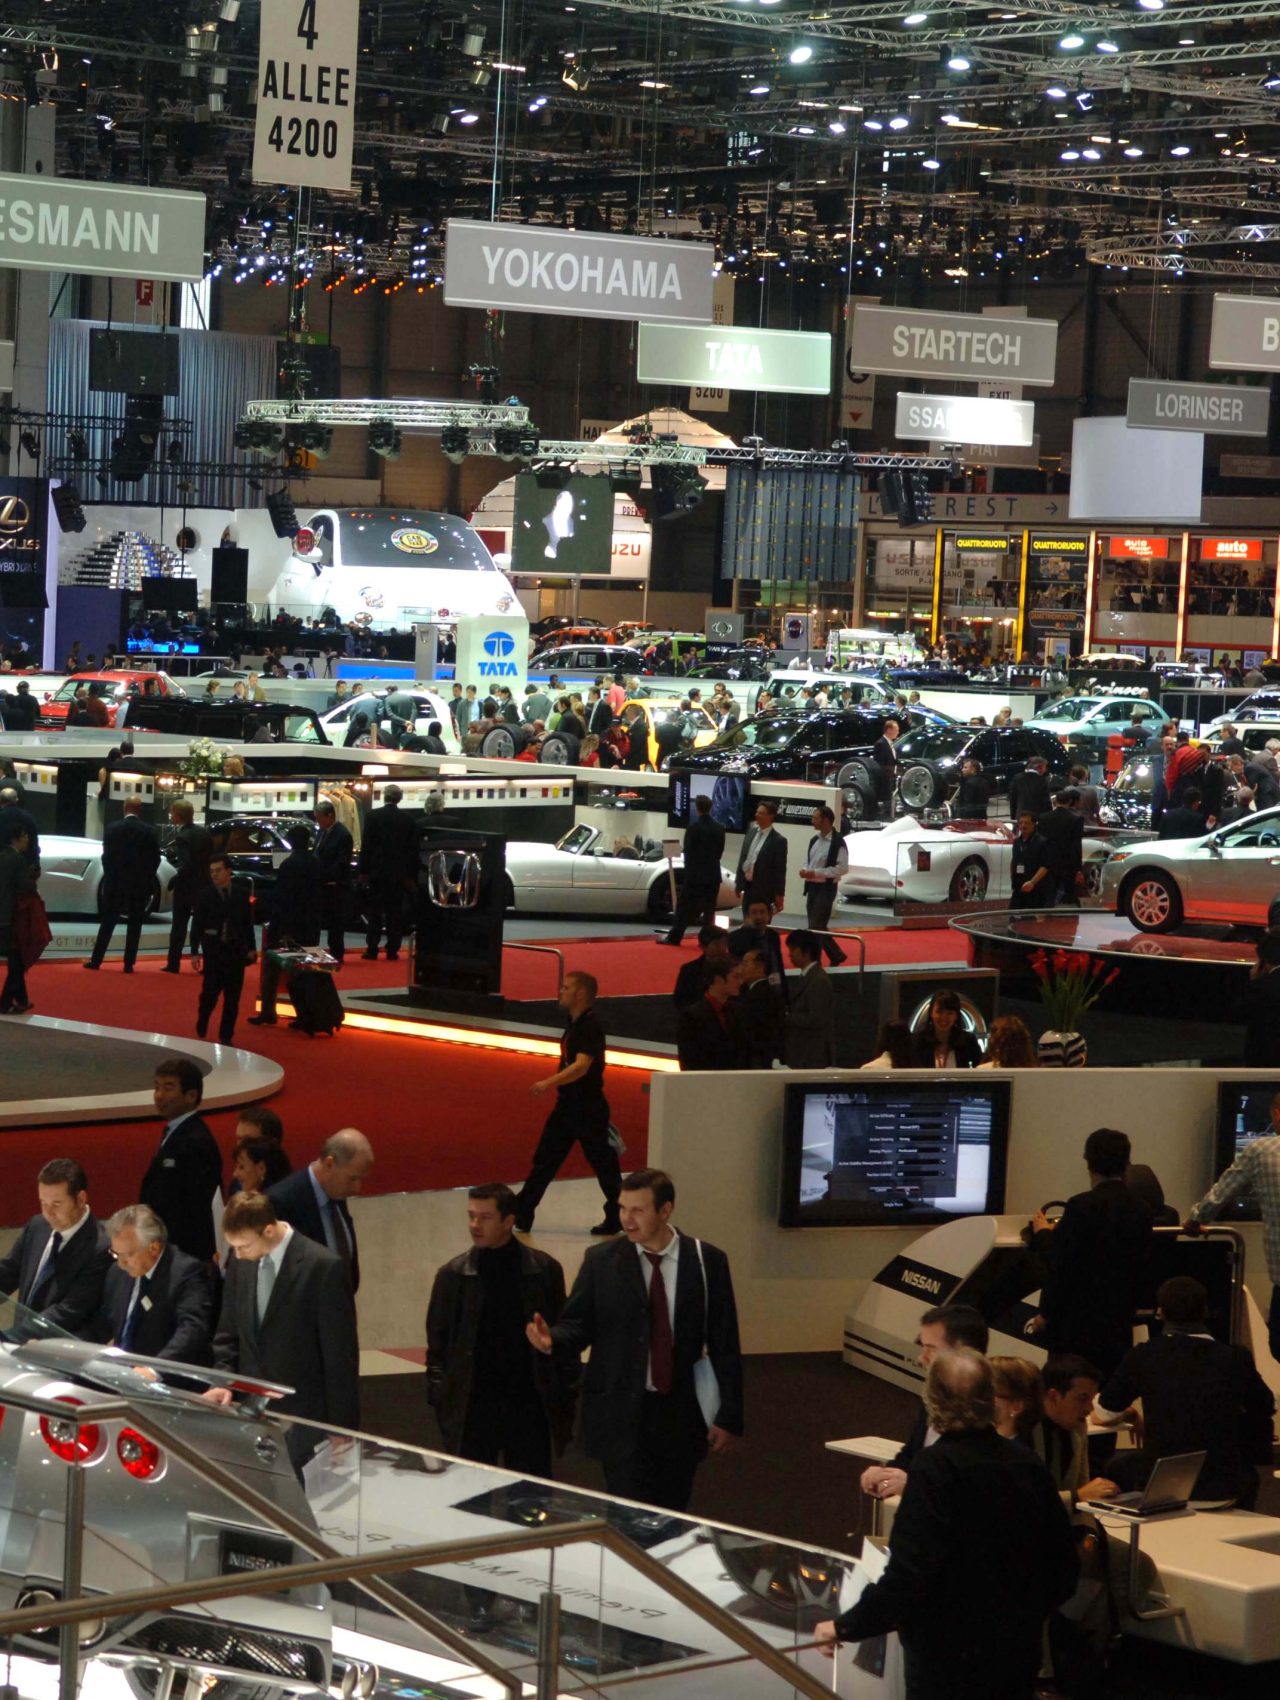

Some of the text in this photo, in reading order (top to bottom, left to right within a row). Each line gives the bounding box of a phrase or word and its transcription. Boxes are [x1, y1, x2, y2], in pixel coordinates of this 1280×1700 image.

[296, 0, 319, 51] 4
[263, 59, 350, 107] ALLEE
[267, 116, 339, 159] 4200
[482, 245, 683, 301] YOKOHAMA
[705, 341, 764, 375] TATA
[892, 325, 1022, 367] STARTECH
[1154, 391, 1245, 425] LORINSER
[610, 543, 641, 556] UZU
[1217, 541, 1248, 553] auto
[477, 662, 519, 676] TATA
[900, 1268, 942, 1295] NISSAN
